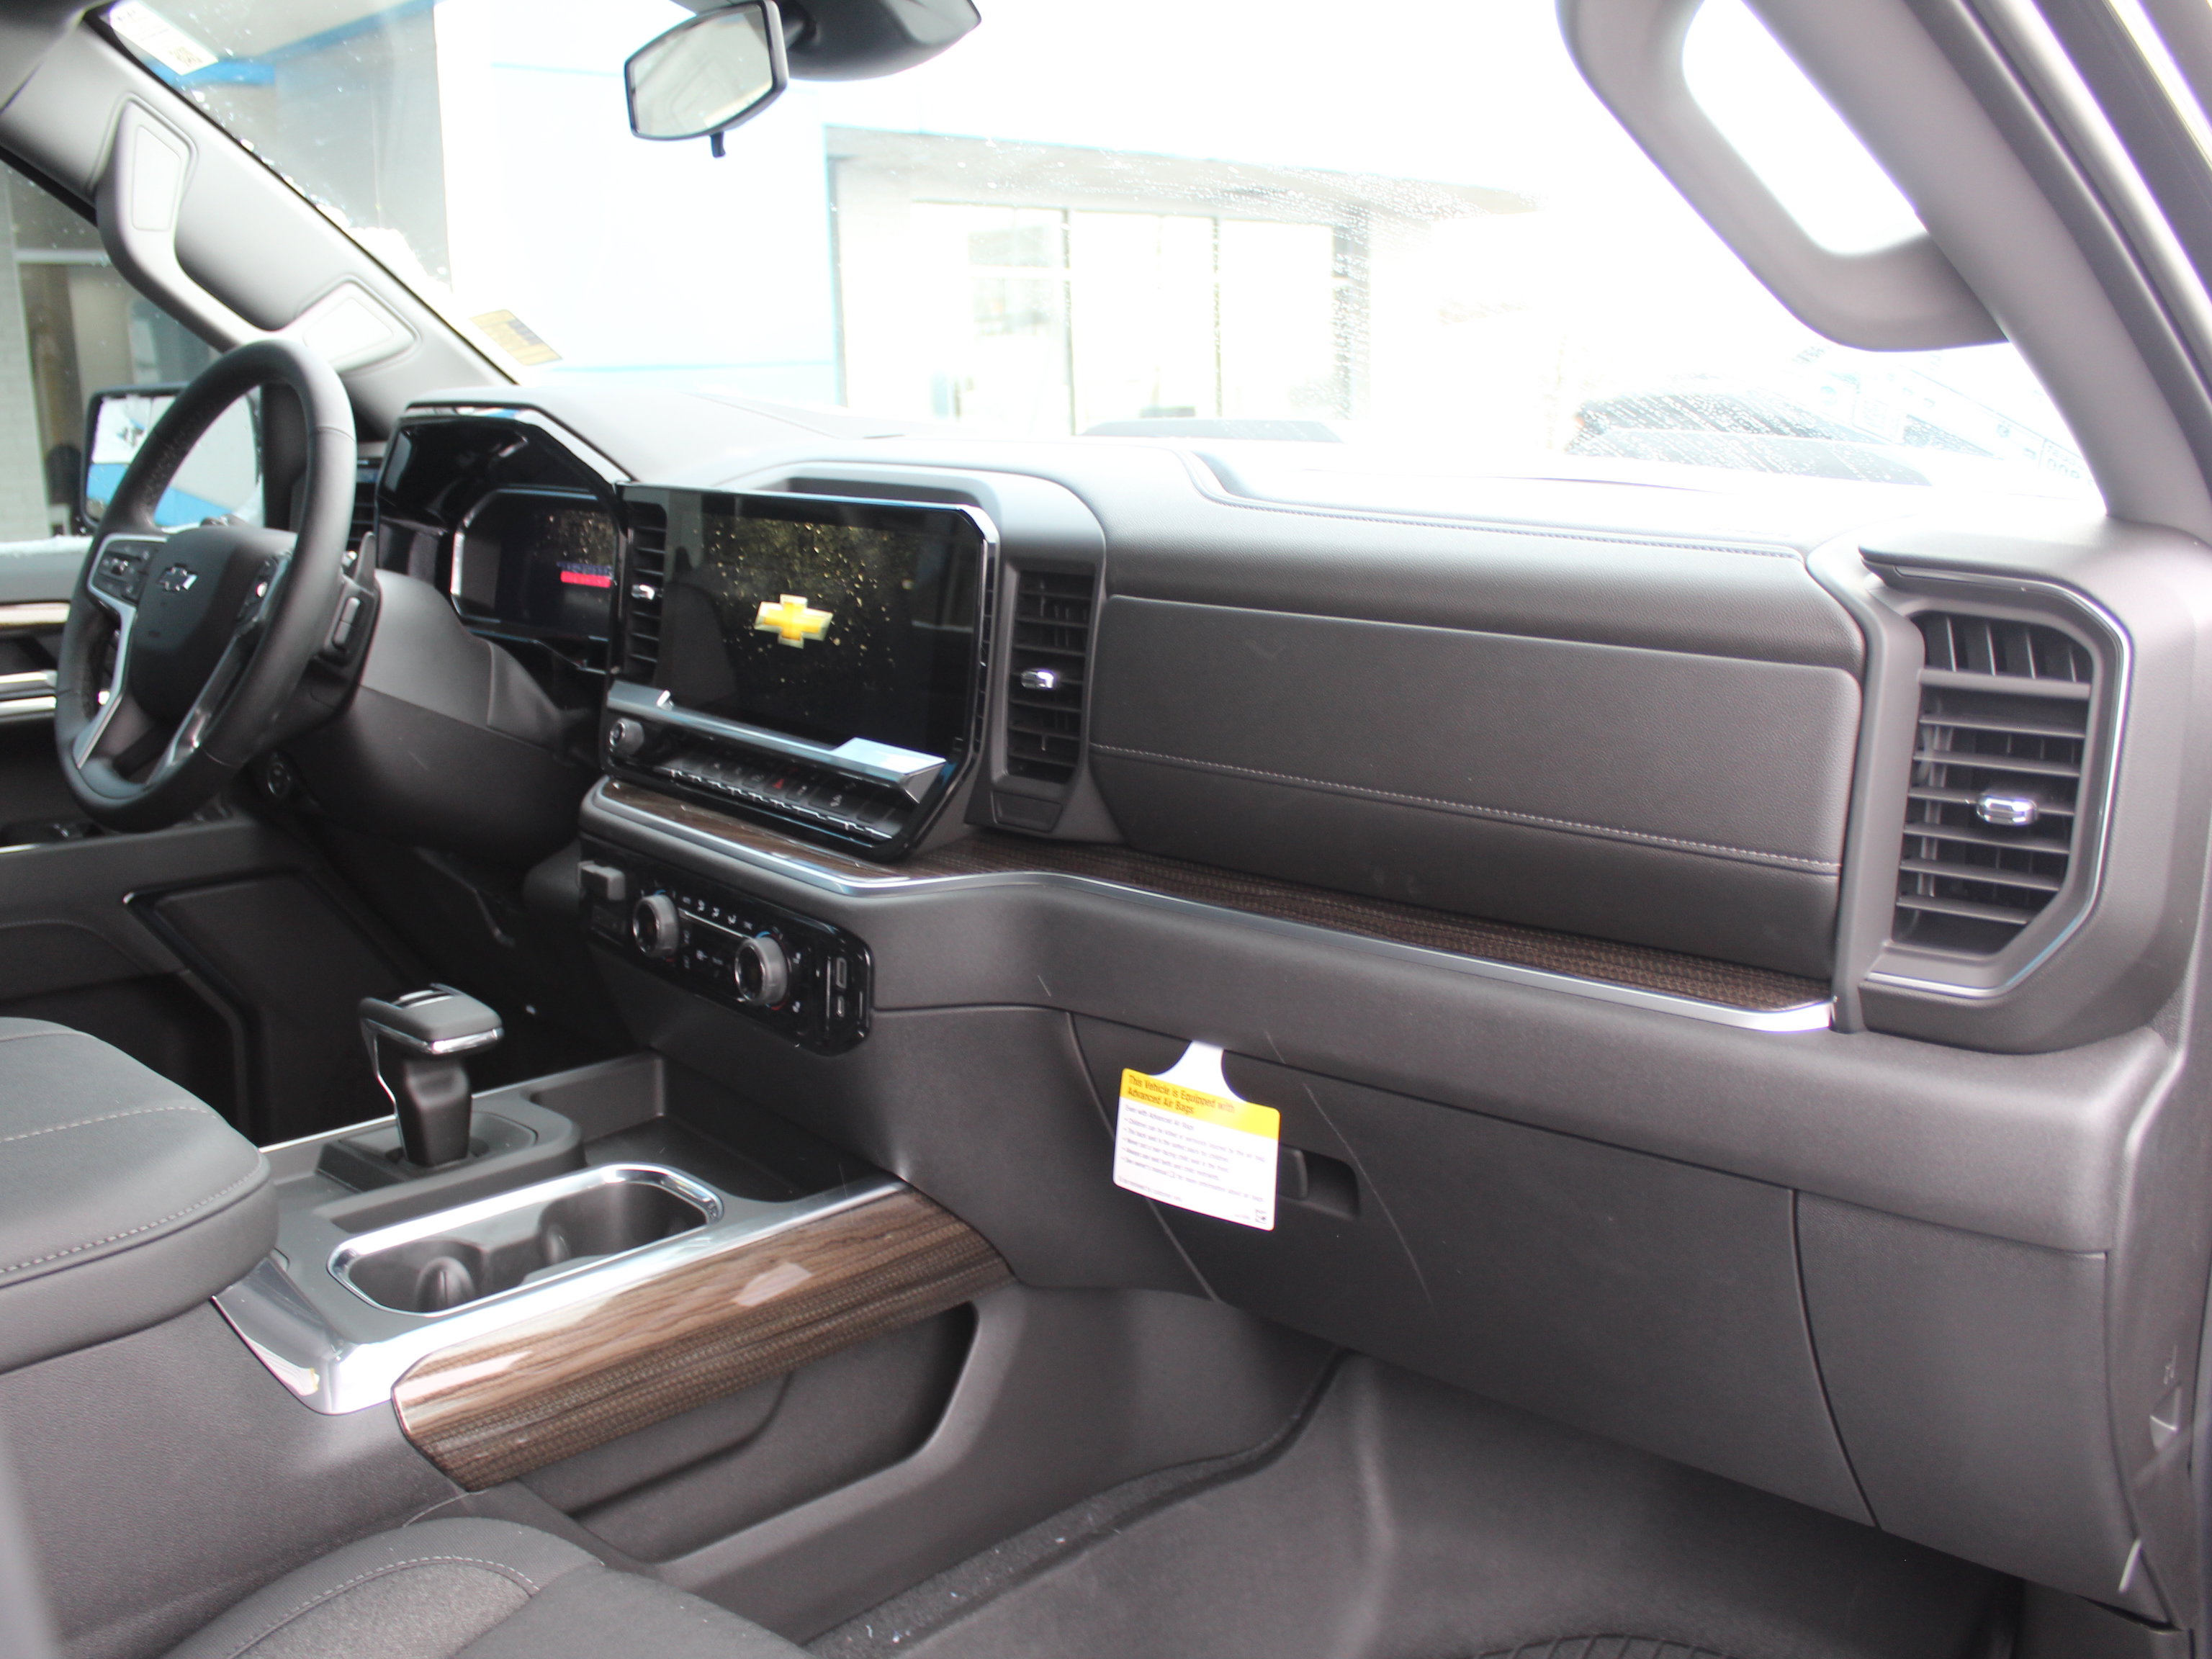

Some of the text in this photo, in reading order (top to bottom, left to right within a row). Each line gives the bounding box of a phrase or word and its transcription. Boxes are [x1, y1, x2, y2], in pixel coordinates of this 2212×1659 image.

[1128, 1074, 1142, 1087] This
[1145, 1081, 1170, 1094] Vehicle
[1173, 1088, 1179, 1097] is
[1181, 1089, 1215, 1107] Equipped
[1128, 1087, 1194, 1114] Advanced Air Bags
